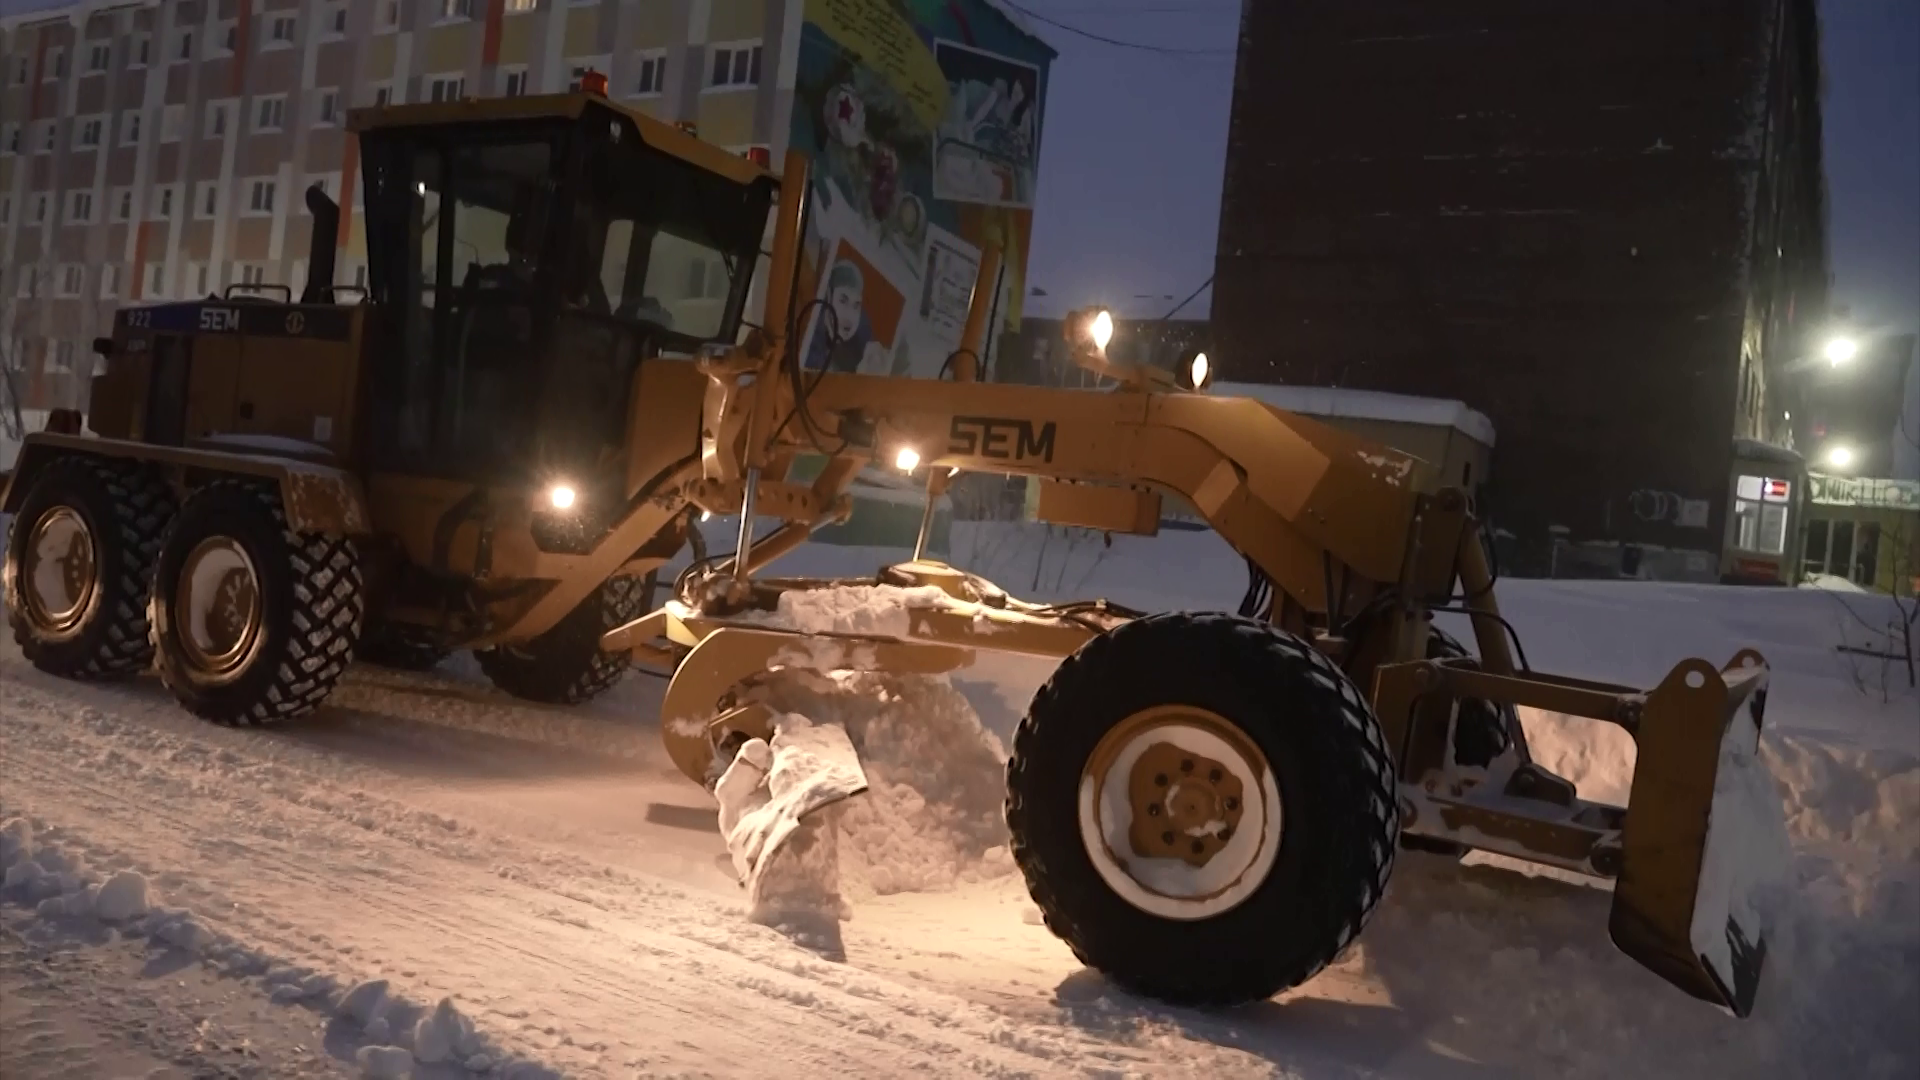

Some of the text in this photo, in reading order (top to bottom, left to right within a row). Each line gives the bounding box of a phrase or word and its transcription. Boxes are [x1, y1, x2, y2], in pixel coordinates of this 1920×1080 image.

[127, 310, 151, 328] 922
[199, 307, 240, 331] SEM
[947, 415, 1057, 464] SEM
